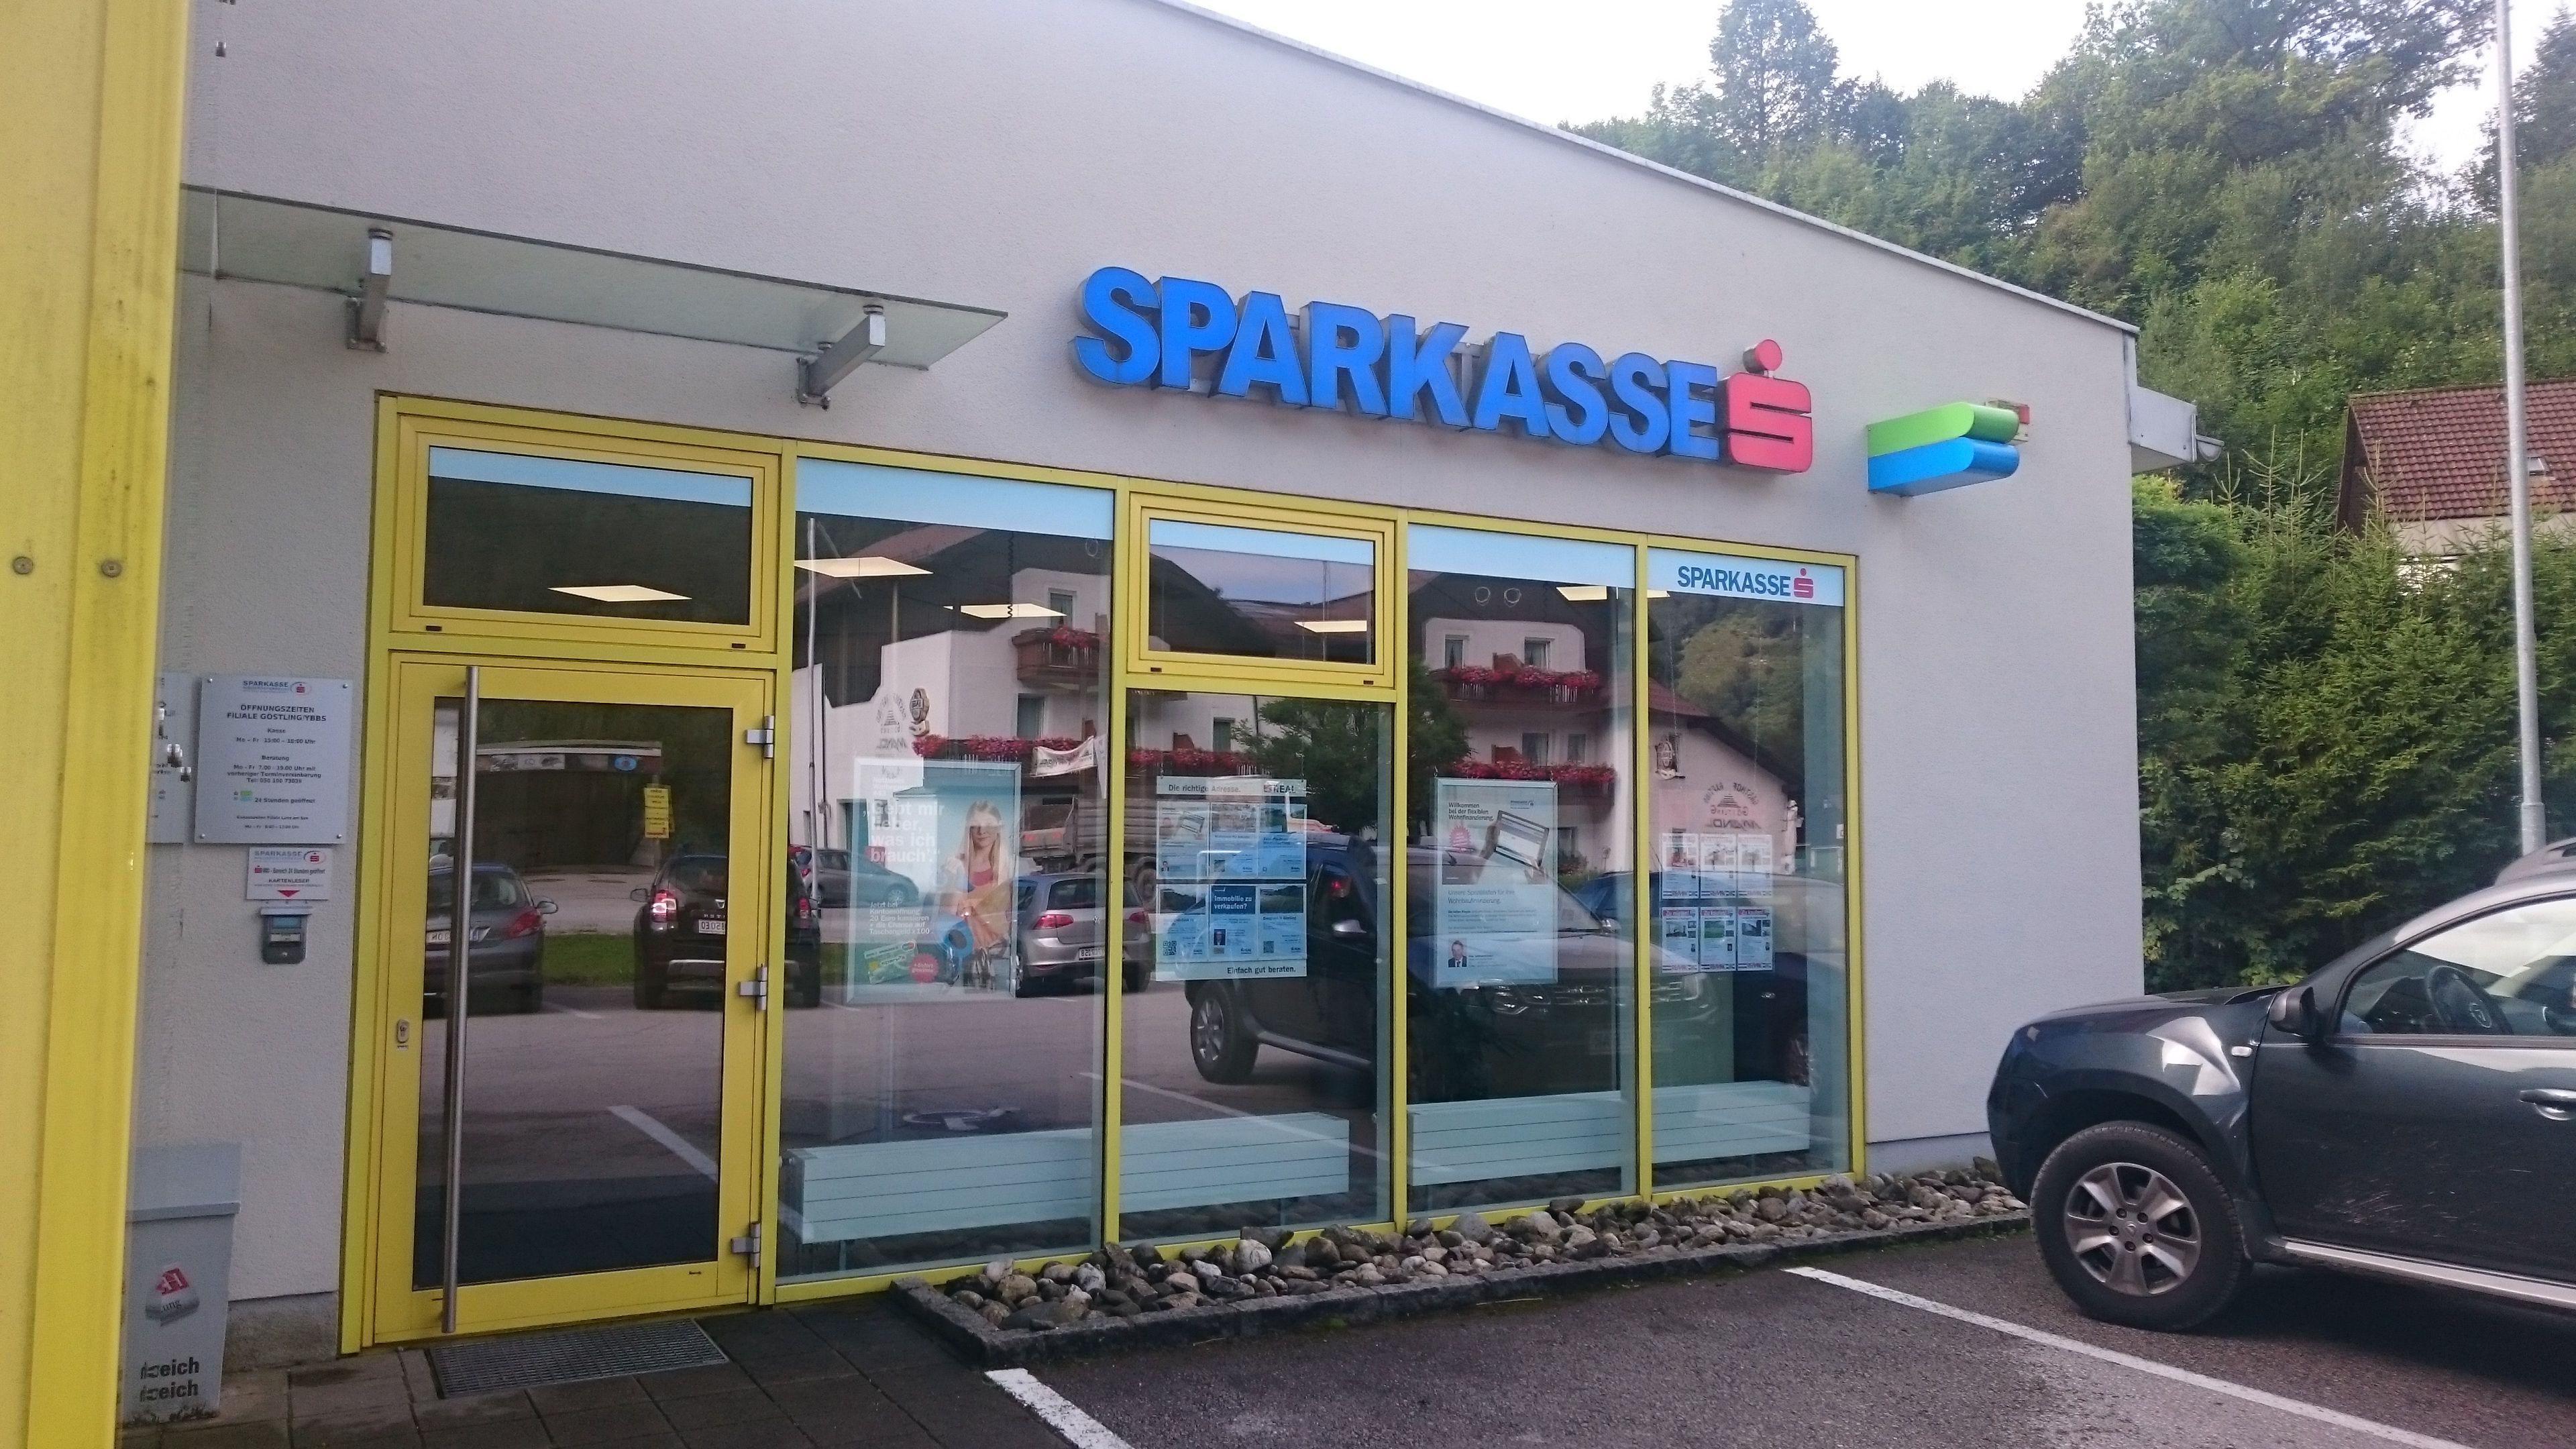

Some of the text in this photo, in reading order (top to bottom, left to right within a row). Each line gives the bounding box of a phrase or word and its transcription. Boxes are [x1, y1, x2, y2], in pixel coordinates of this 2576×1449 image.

[1074, 266, 1721, 461] SPARKASSE
[1677, 566, 1791, 597] SPARKASSE
[1168, 784, 1180, 792] Die
[1182, 784, 1208, 794] richtige
[917, 802, 945, 816] mir
[871, 830, 936, 846] was ich
